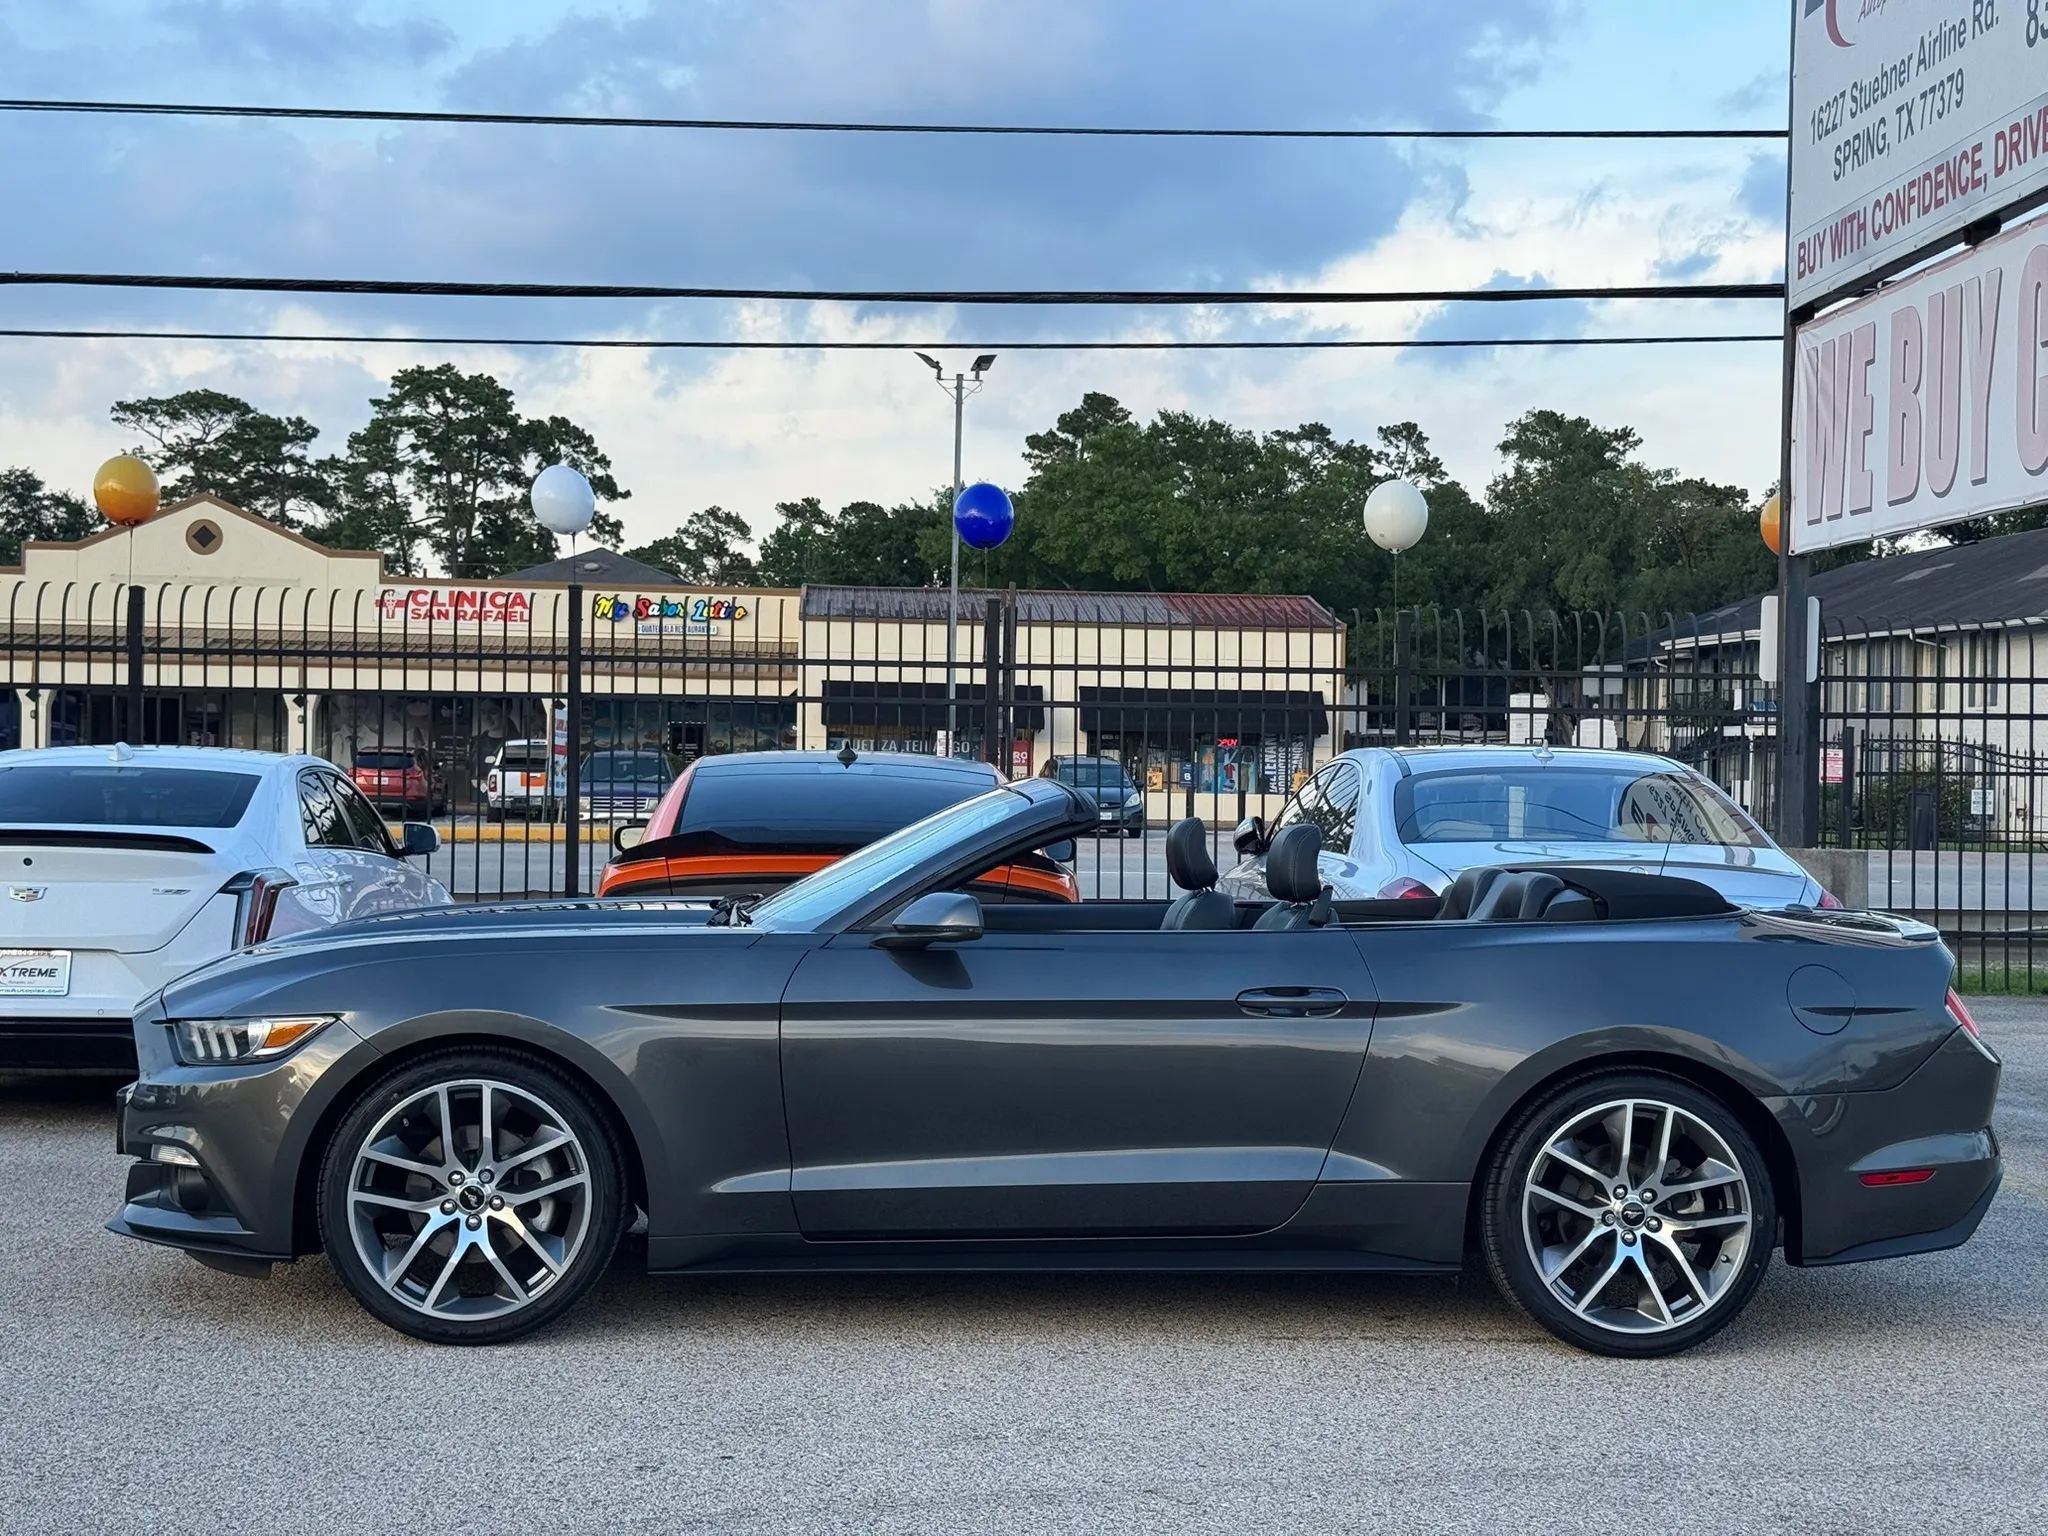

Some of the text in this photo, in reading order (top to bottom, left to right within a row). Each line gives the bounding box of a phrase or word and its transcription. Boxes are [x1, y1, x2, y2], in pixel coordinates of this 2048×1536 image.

[1810, 89, 1846, 145] 16227
[1849, 53, 1914, 119] Stuebner
[1915, 19, 1967, 77] Airline
[1972, 0, 1999, 40] Rd.
[1833, 67, 1965, 182] SPRING, TX 77379
[1798, 104, 2048, 280] BUY WITH CONFIDENCE, DRIVE
[1806, 321, 1876, 526] WE
[1887, 267, 2003, 507] BUY
[410, 608, 530, 623] SAN RAFAEL
[411, 589, 529, 609] CLINICA
[632, 598, 687, 620] Sabor
